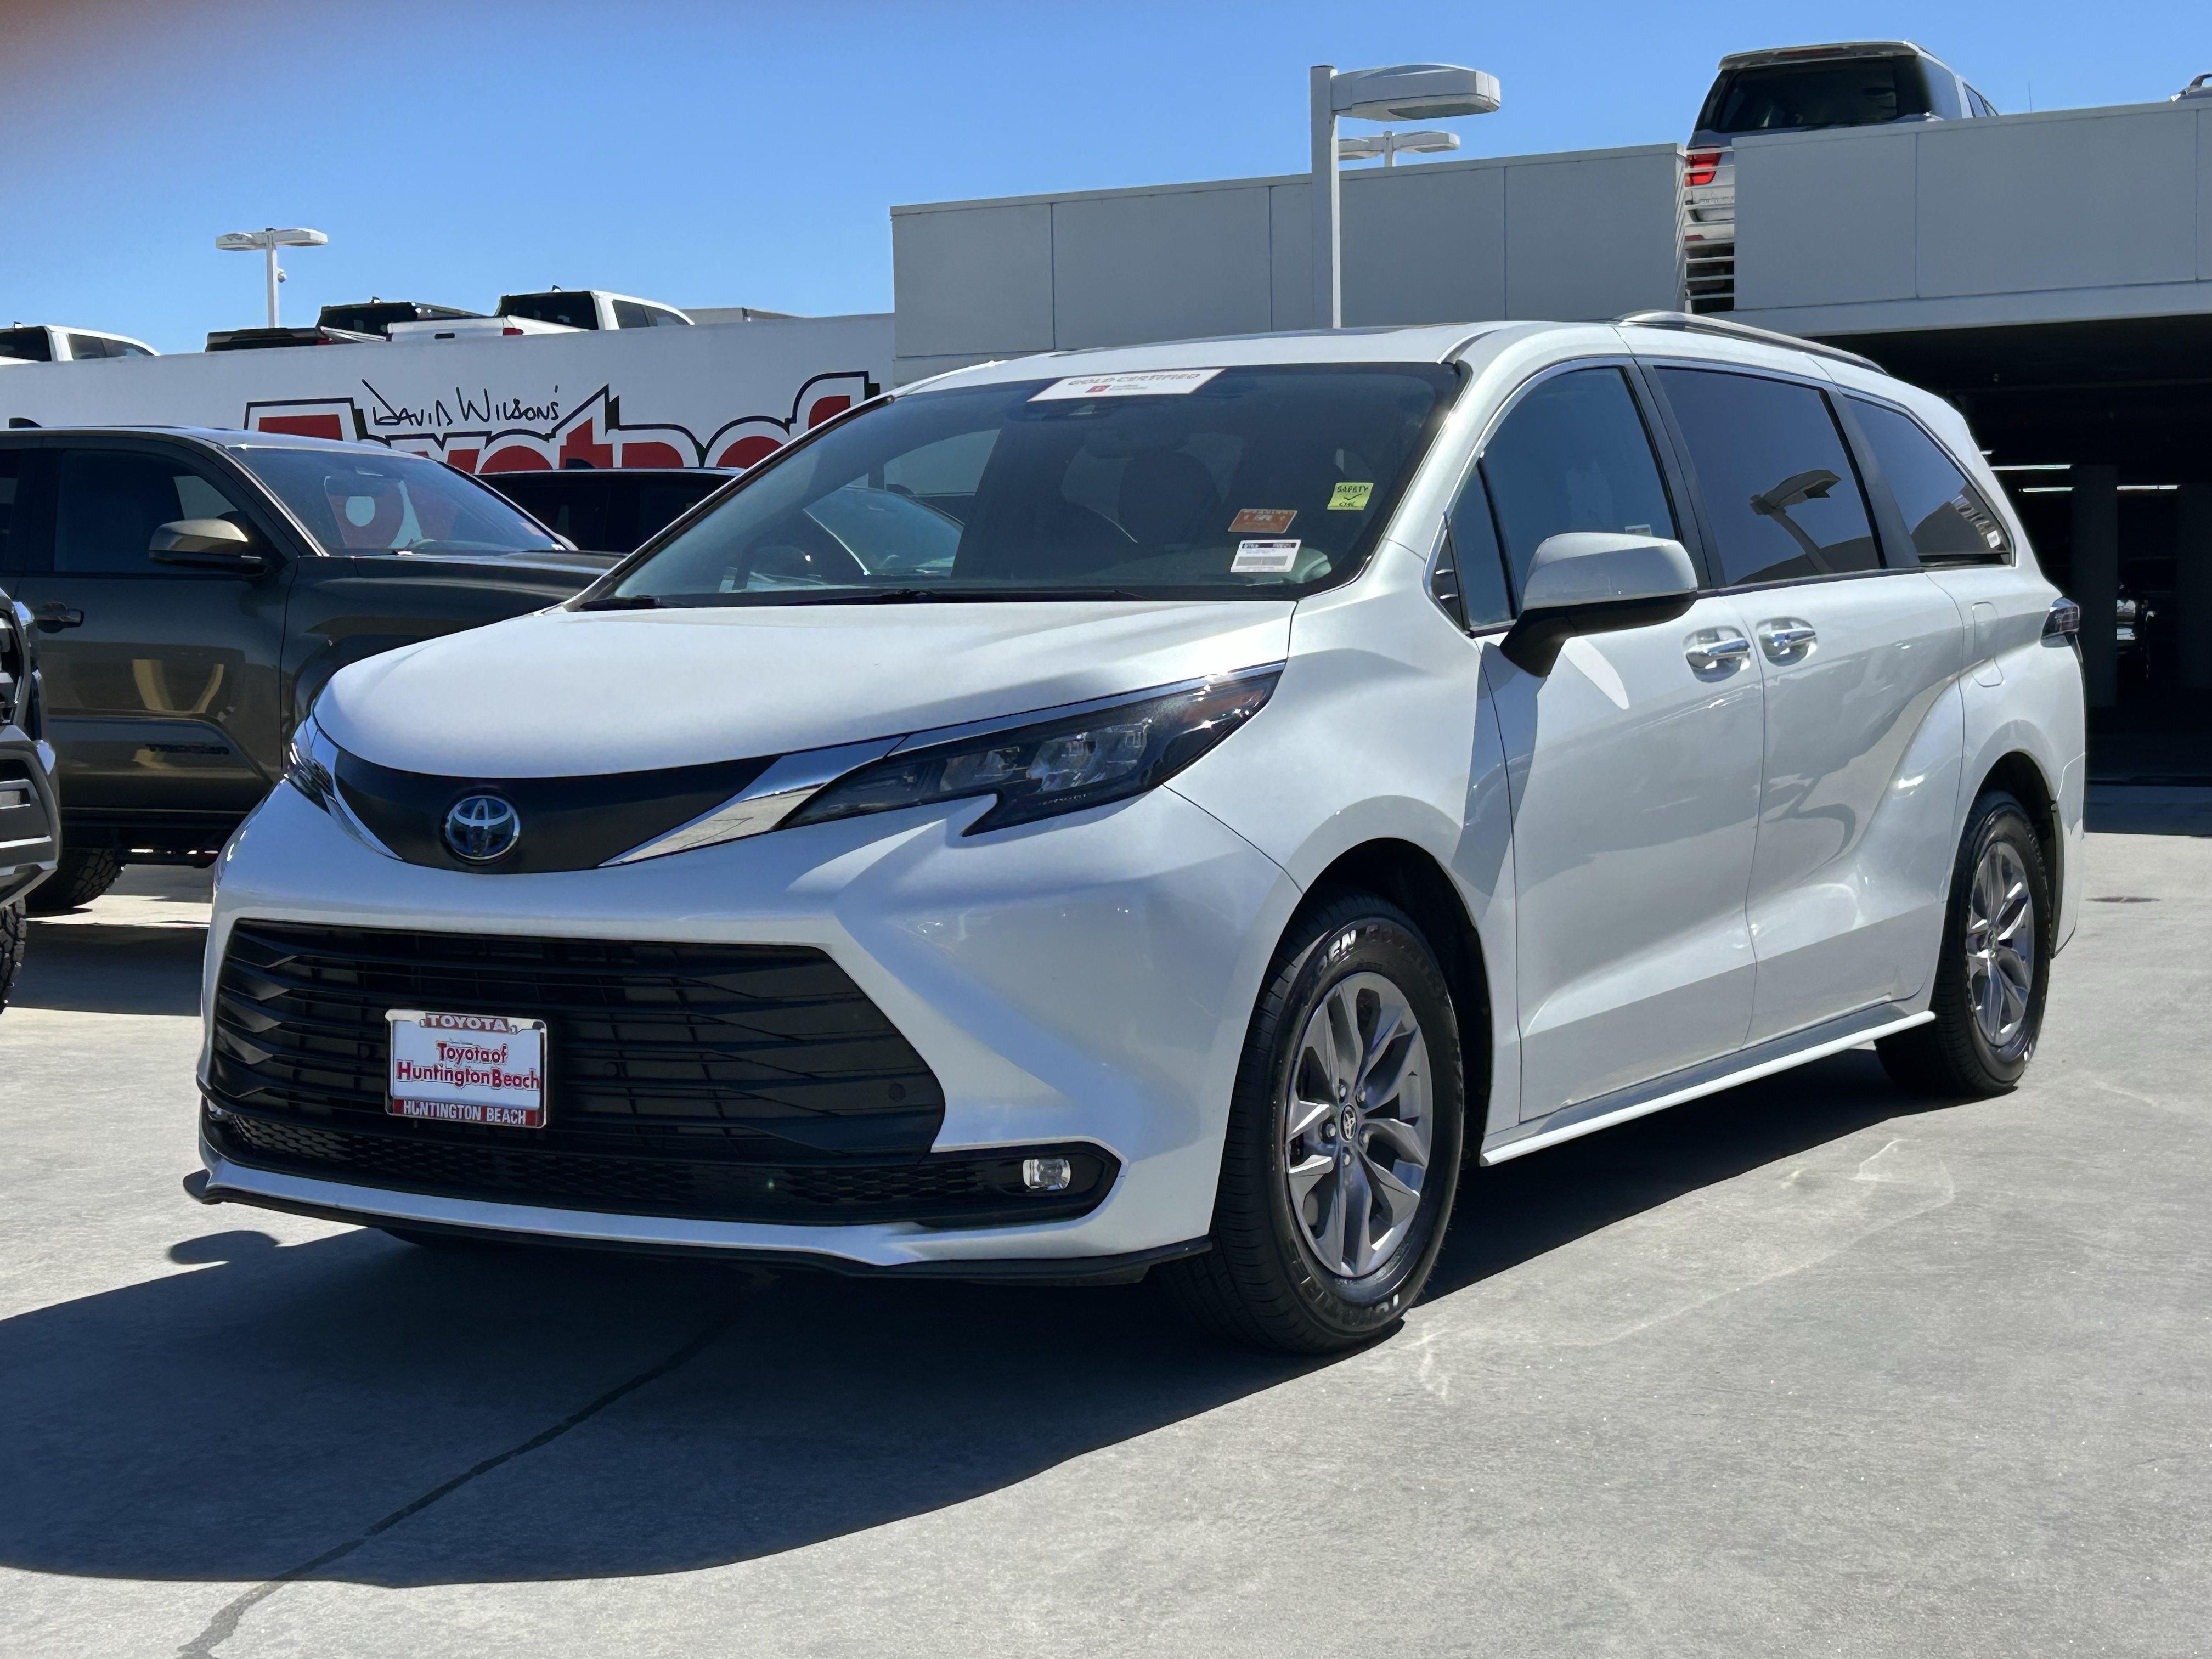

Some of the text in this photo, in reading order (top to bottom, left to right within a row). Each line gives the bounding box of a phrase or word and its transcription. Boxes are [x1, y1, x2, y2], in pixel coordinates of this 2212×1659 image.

[427, 1015, 507, 1031] TOYOTA
[438, 1042, 507, 1066] Toyota of
[397, 1060, 540, 1090] Huntington Beach
[403, 1100, 526, 1125] HUNTINGTON BEACH
